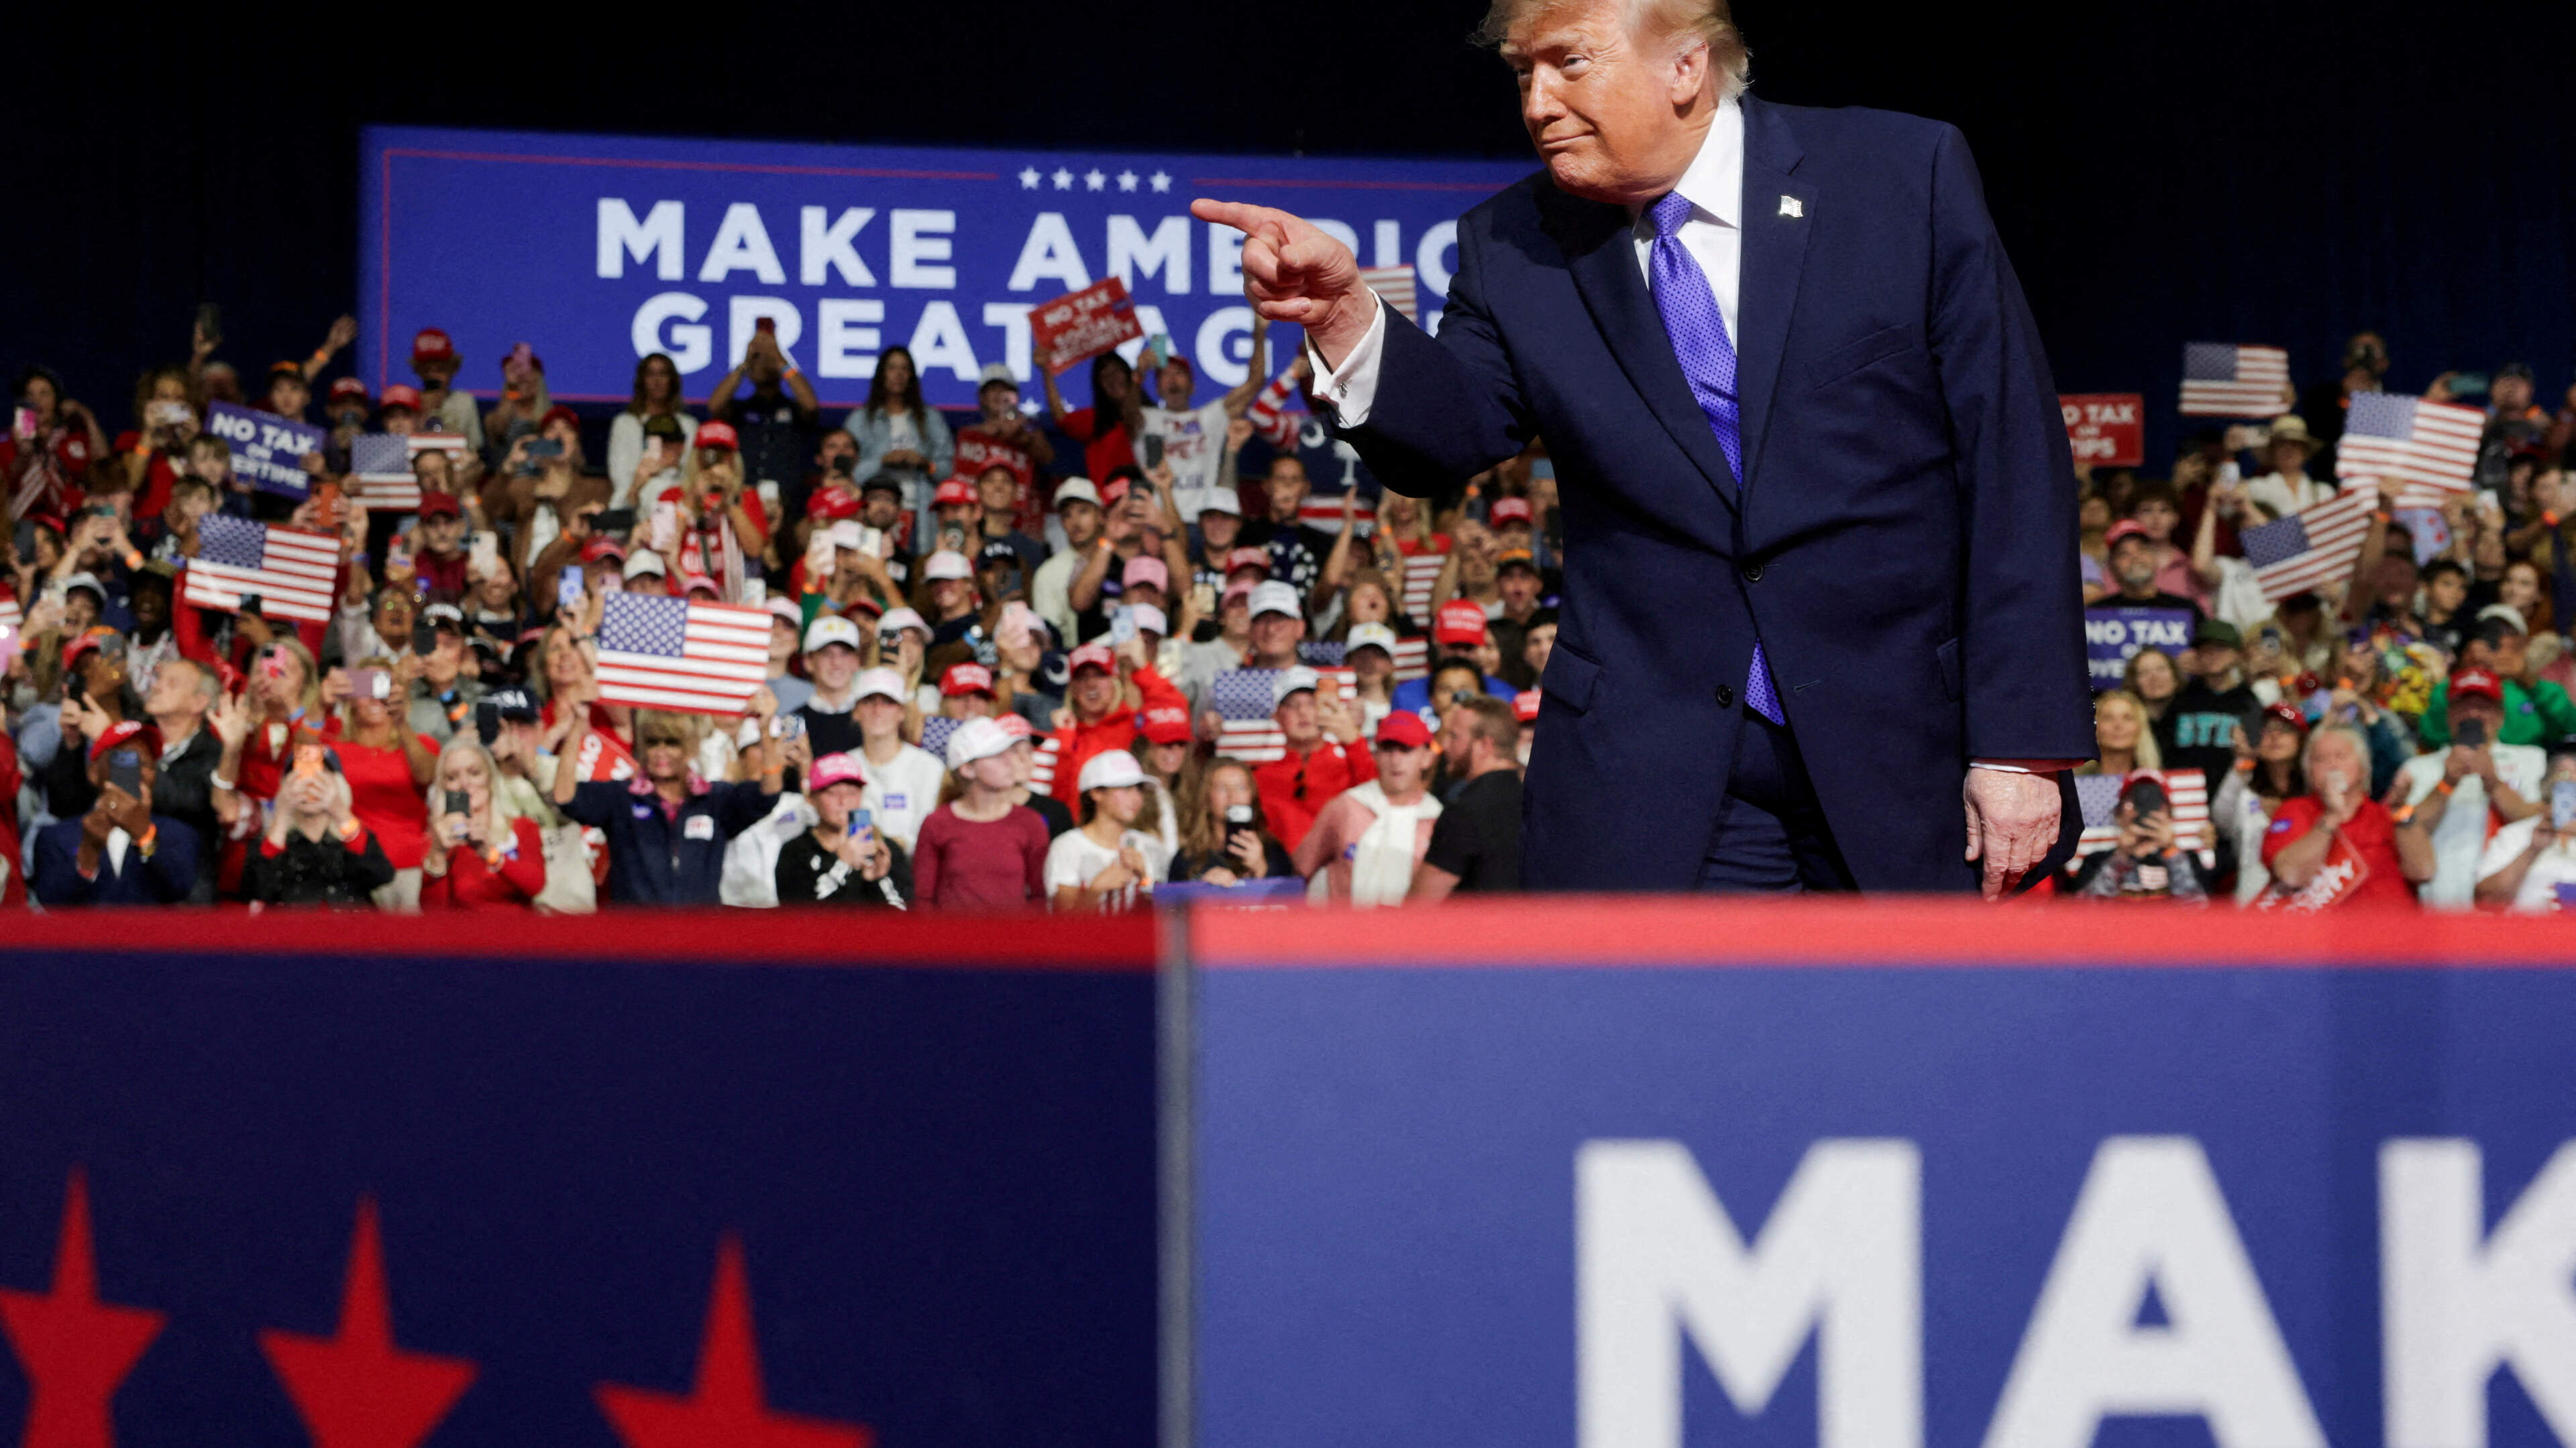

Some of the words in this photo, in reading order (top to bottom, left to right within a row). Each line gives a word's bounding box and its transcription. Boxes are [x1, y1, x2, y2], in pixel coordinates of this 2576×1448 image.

[597, 198, 957, 289] MAKE
[1043, 304, 1073, 328] NO
[631, 291, 1037, 382] GREAT
[2061, 404, 2080, 426] O
[2084, 403, 2136, 425] TAX
[211, 412, 256, 443] NO
[260, 423, 315, 457] TAX
[230, 451, 309, 490] ERTIME
[2085, 620, 2127, 645] NO
[2129, 620, 2188, 646] TAX
